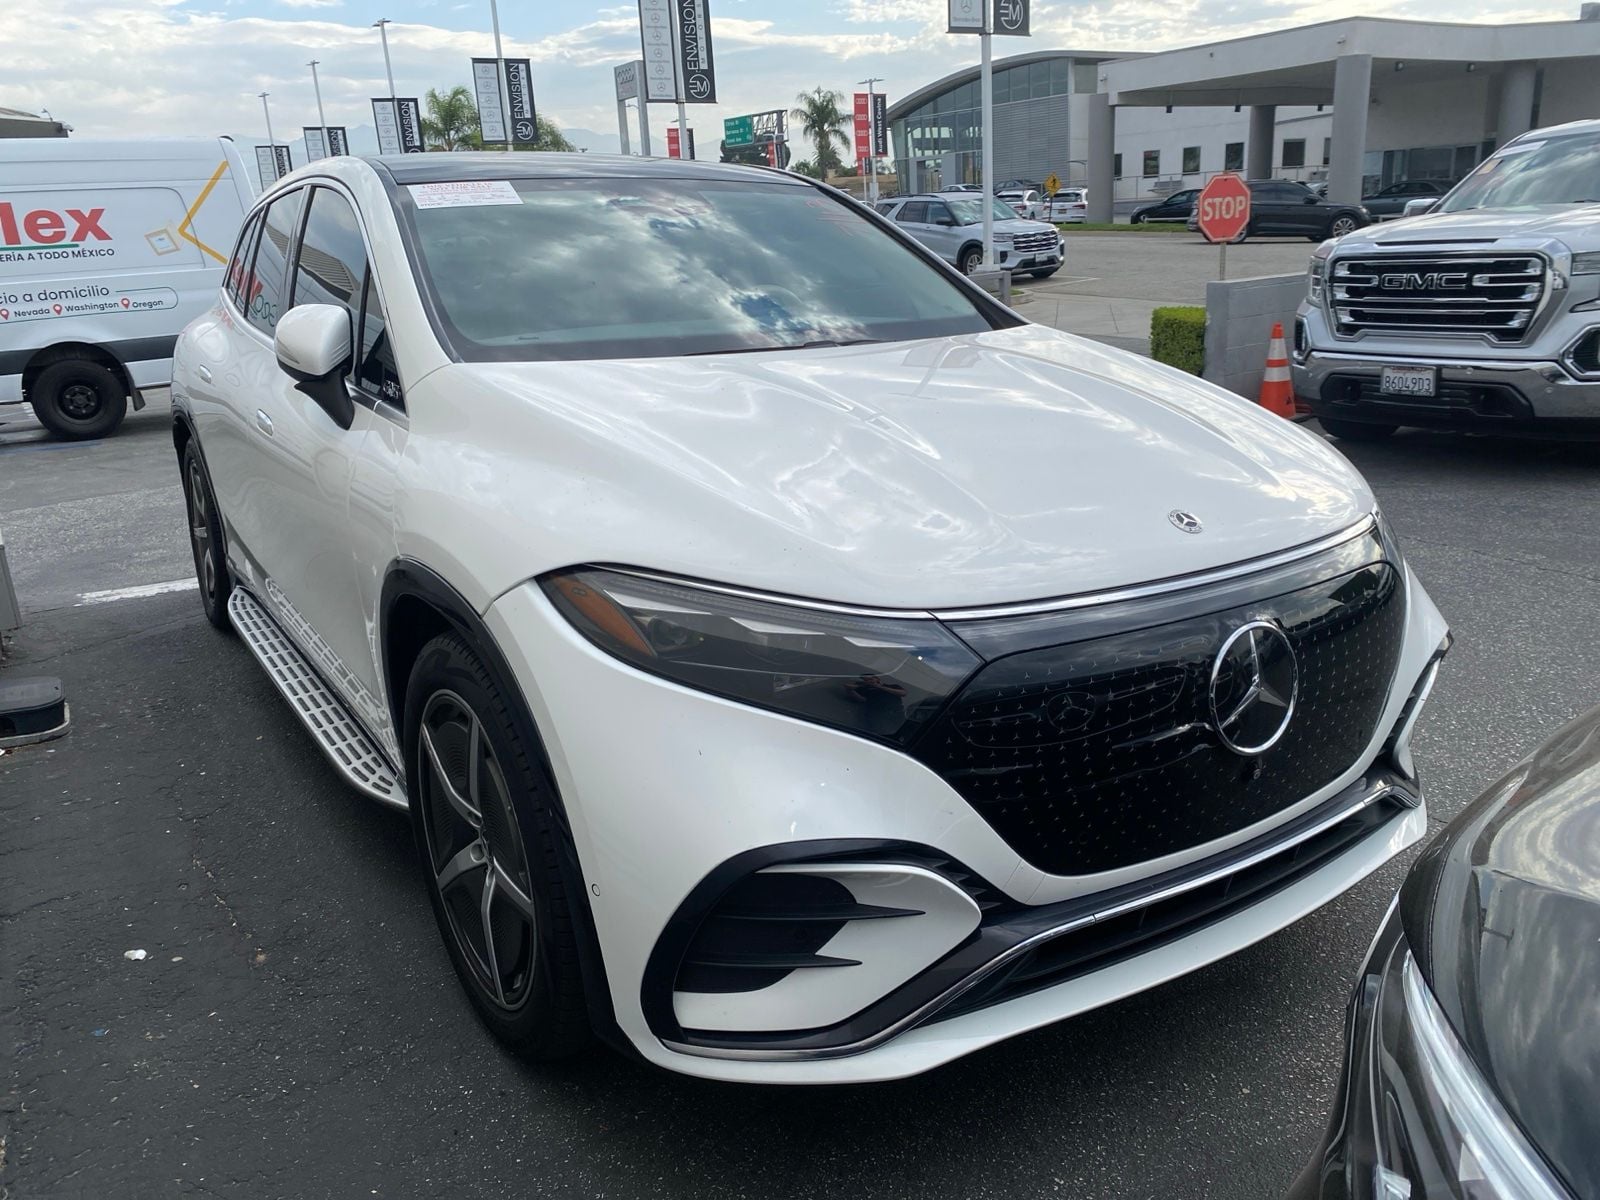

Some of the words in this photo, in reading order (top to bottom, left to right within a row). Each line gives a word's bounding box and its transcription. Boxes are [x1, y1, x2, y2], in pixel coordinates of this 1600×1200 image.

[683, 0, 698, 70] ENVISION
[509, 63, 524, 119] ENVISION
[401, 102, 414, 146] ENVISION
[1203, 195, 1246, 221] STOP
[28, 253, 35, 261] A
[37, 250, 69, 260] TODO
[71, 248, 115, 258] MÉXICO
[1380, 272, 1468, 290] GMC
[23, 293, 33, 302] a
[38, 285, 110, 301] domicilio
[65, 301, 119, 312] Washington
[132, 299, 164, 309] Oregon
[14, 308, 50, 318] Nevada
[1384, 375, 1431, 391] 86049D3
